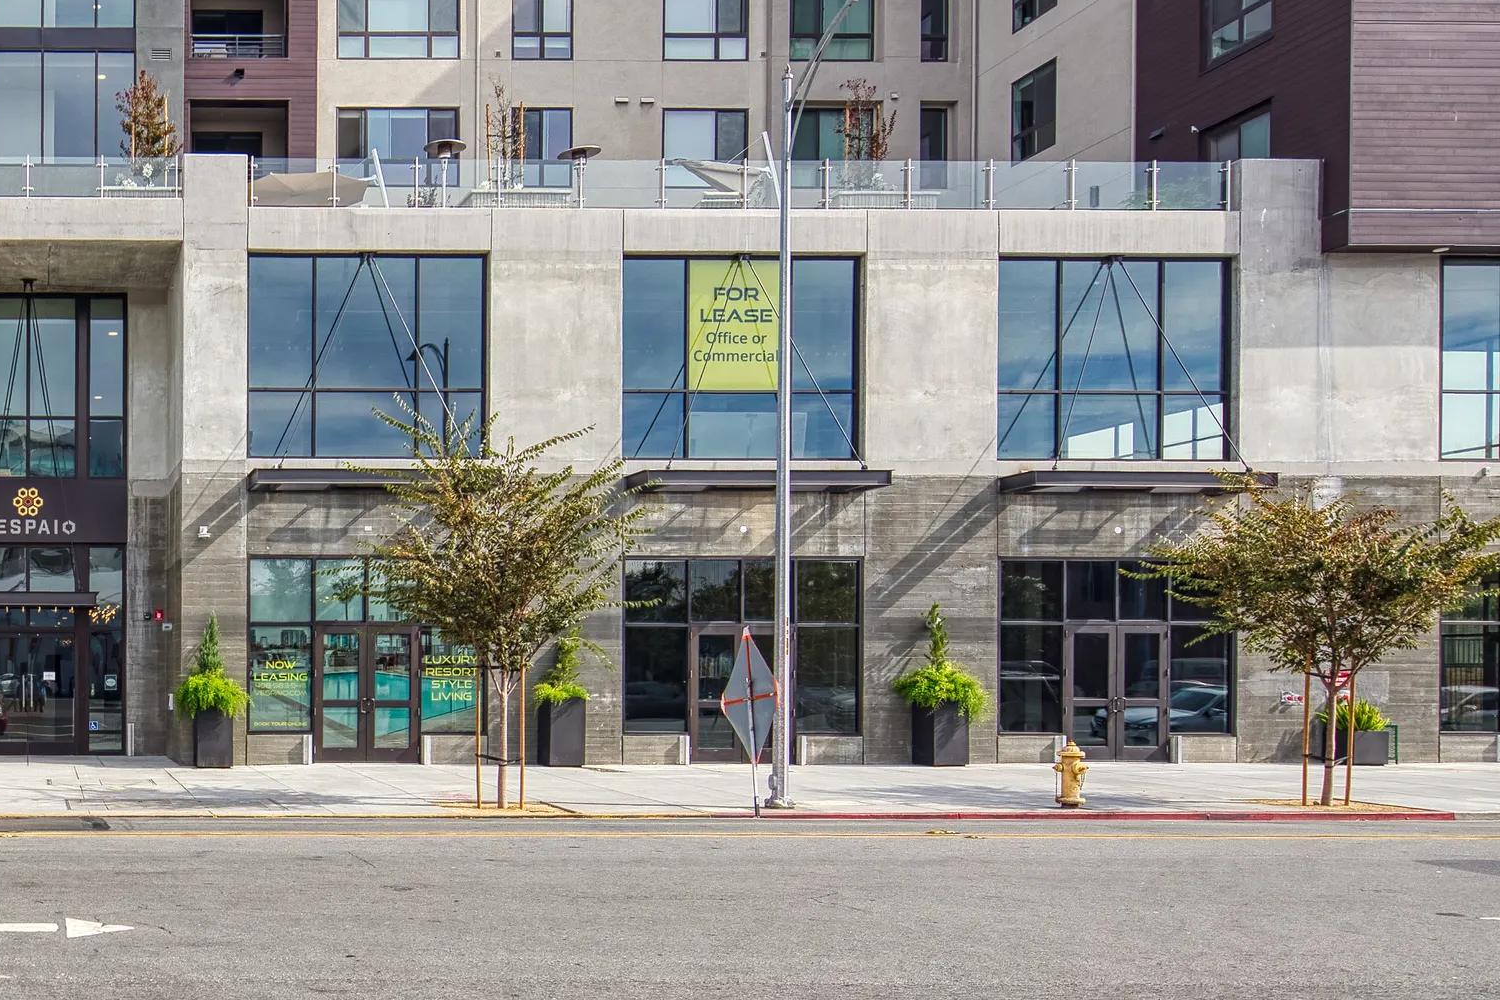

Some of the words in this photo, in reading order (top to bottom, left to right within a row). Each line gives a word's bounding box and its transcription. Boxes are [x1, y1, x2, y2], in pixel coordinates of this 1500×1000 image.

[713, 287, 759, 301] FOR
[700, 308, 773, 323] LEASE
[706, 332, 748, 344] Office
[752, 335, 768, 344] or
[693, 350, 779, 362] Commercial
[425, 655, 477, 664] LUXURY
[265, 660, 297, 669] NOW
[425, 667, 477, 676] RESORT
[253, 672, 308, 681] LEASING
[431, 680, 472, 688] STYLE
[431, 691, 472, 701] LIVING
